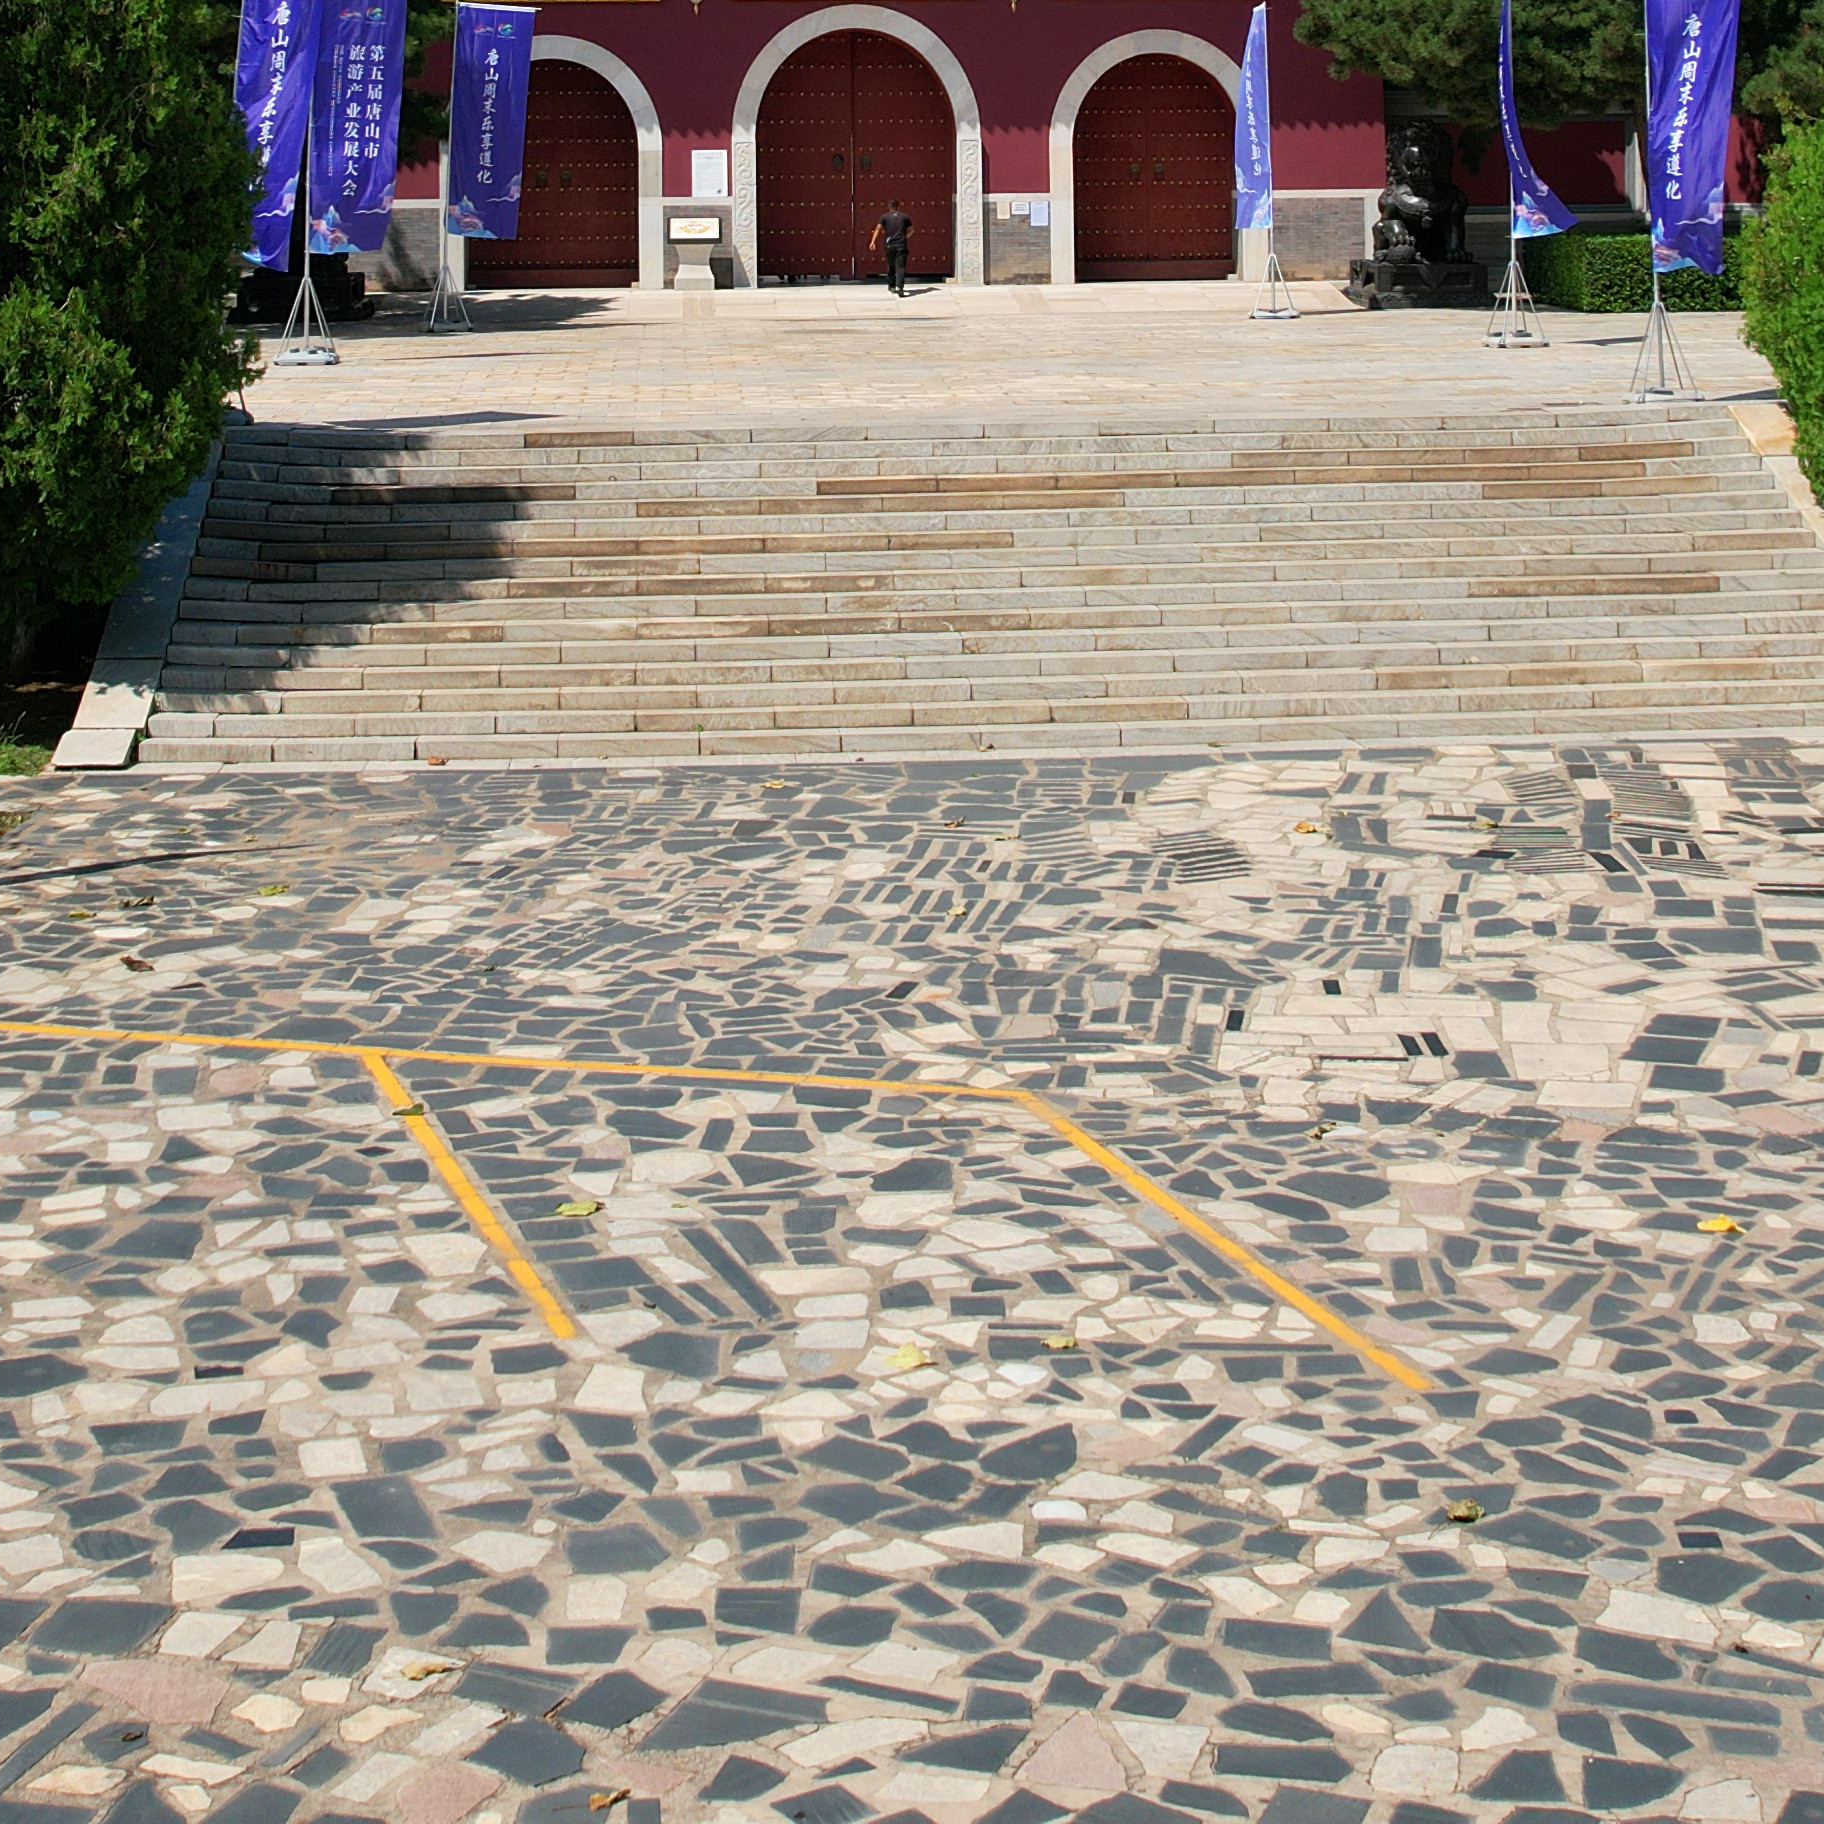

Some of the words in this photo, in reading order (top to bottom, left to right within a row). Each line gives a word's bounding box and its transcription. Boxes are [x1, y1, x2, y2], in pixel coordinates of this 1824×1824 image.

[250, 0, 291, 191] 唐山周末乐享
[342, 44, 367, 197] 旅游产业发展大会
[364, 44, 386, 159] 第五届唐山市
